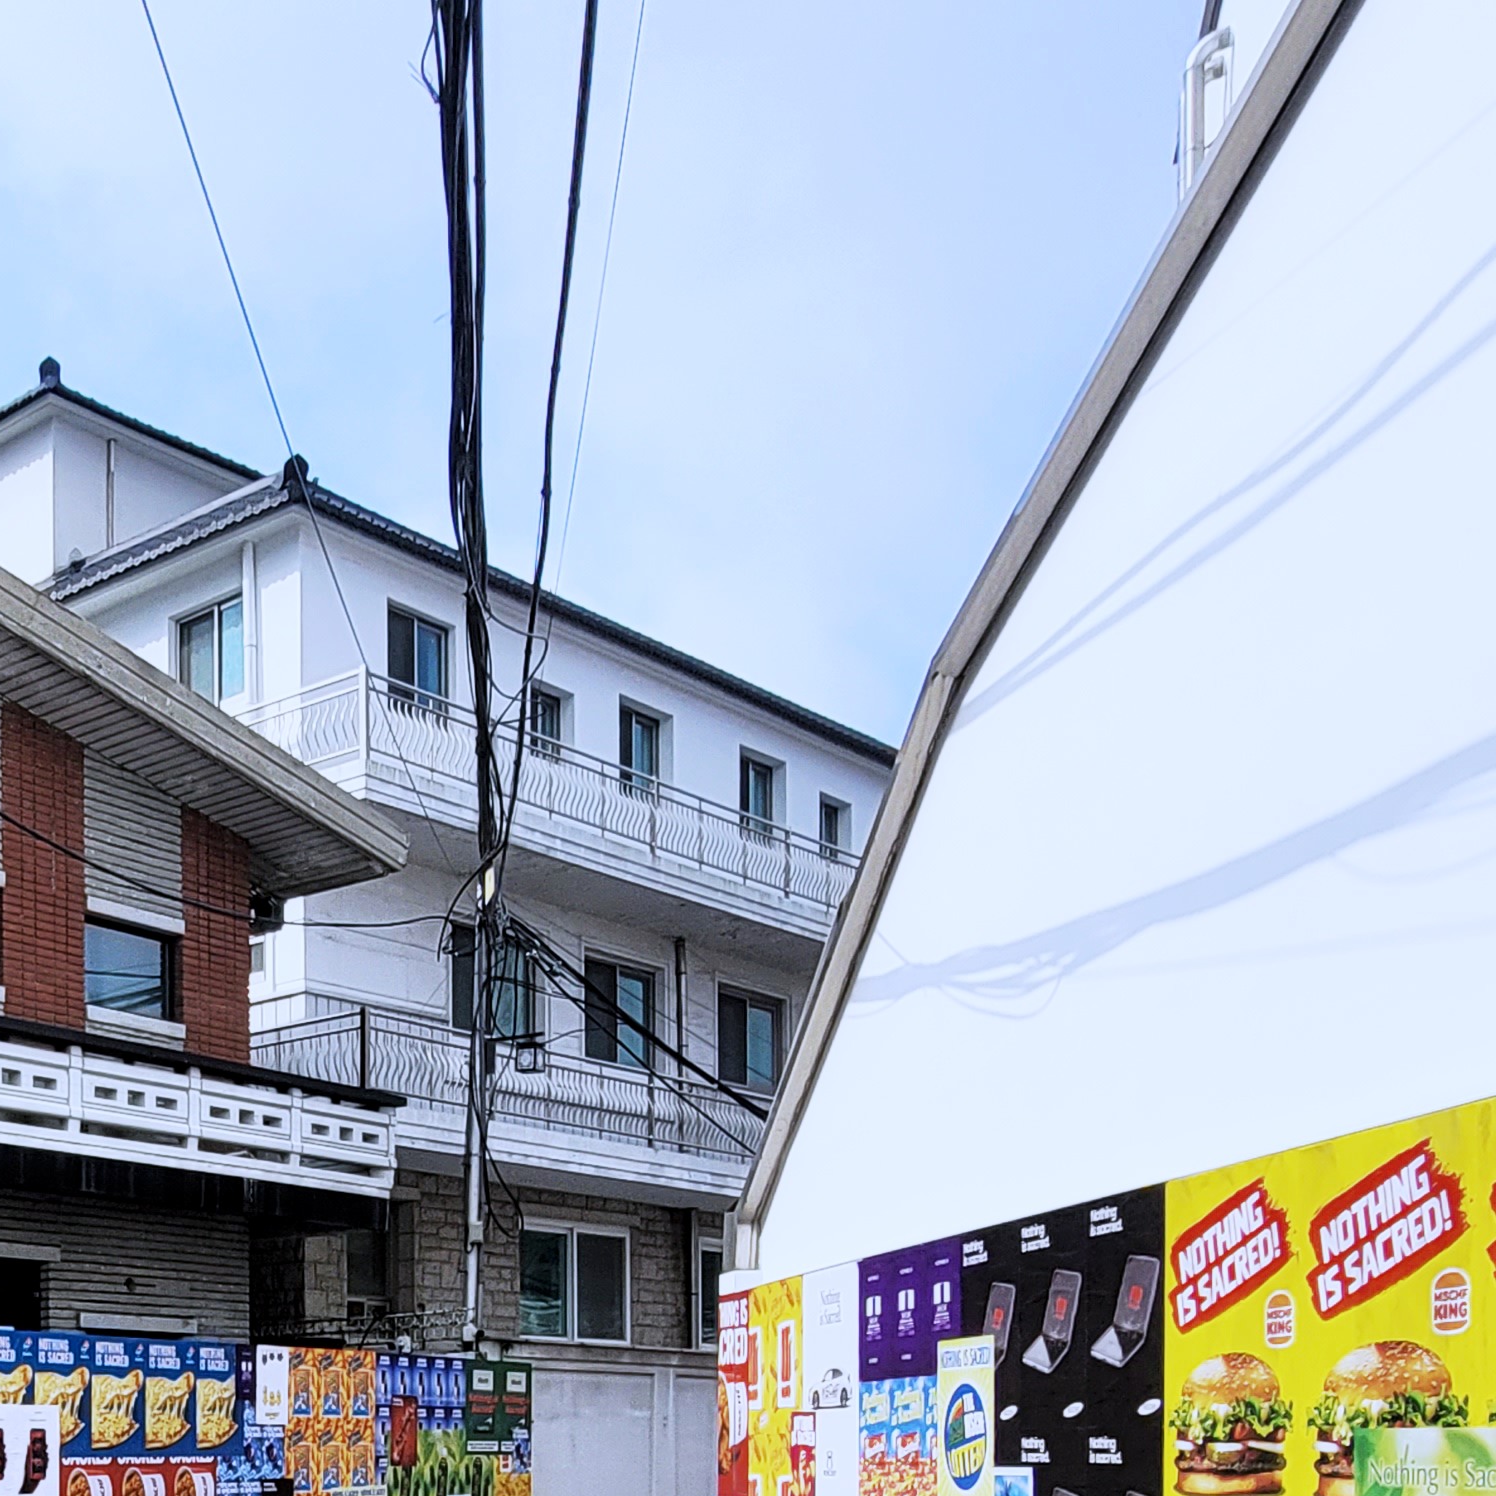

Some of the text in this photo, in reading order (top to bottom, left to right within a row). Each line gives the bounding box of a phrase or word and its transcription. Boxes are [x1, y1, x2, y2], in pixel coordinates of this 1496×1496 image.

[1320, 1154, 1430, 1263] NOTHING
[1178, 1192, 1265, 1284] NOTHING
[1317, 1190, 1453, 1312] IS SACRED!
[1176, 1222, 1281, 1326] IS SACRED!
[1267, 1321, 1292, 1335] KING
[1434, 1302, 1467, 1320] KING
[38, 1338, 69, 1352] NOTHING
[48, 1351, 74, 1365] SACRED
[1368, 1443, 1439, 1496] Nothing
[1444, 1467, 1458, 1485] is
